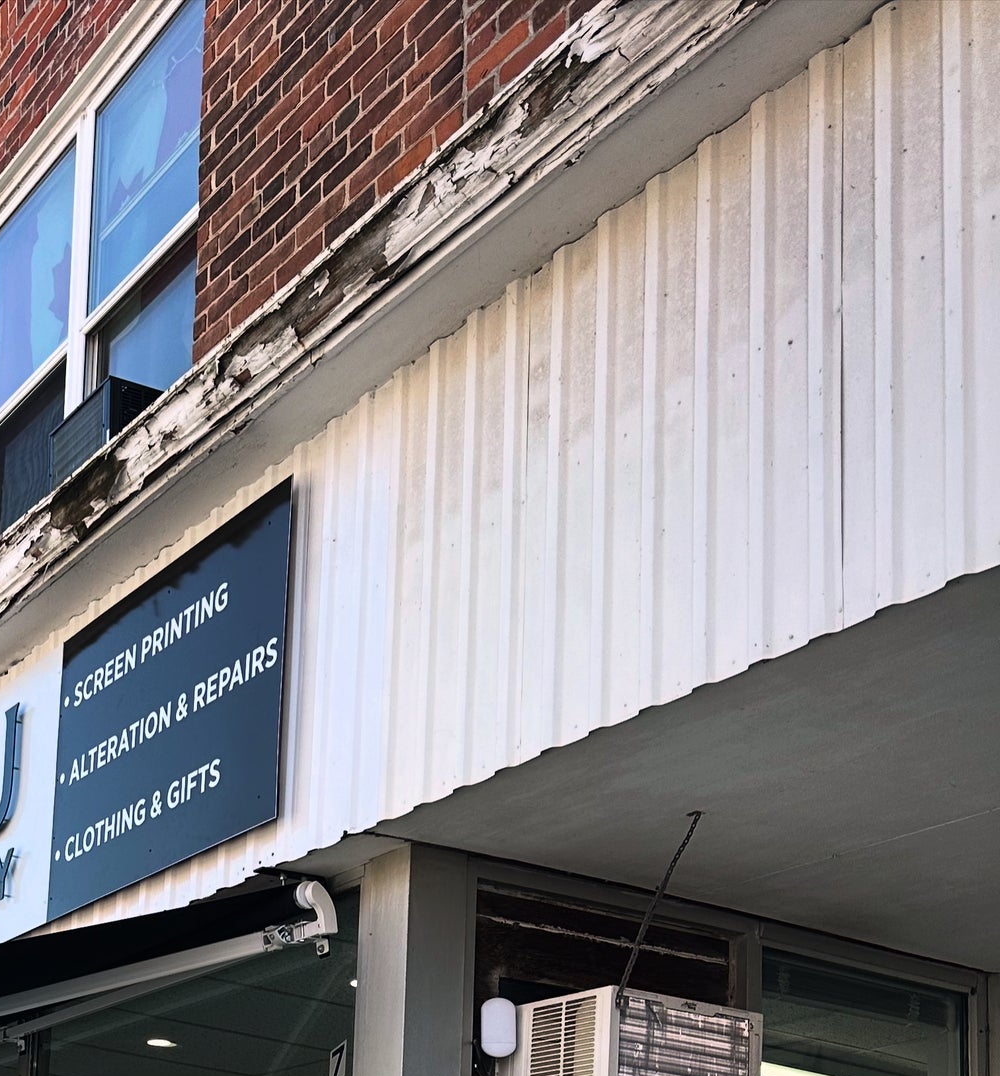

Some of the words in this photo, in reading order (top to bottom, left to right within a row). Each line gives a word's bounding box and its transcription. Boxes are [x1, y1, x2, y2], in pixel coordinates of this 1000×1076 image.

[73, 642, 137, 707] SCREEN
[140, 582, 230, 665] PRINTING
[68, 701, 172, 785] ALTERATION
[175, 692, 188, 719] &
[192, 637, 279, 706] REPAIRS
[64, 797, 147, 862] CLOTHING
[149, 790, 162, 816] &
[166, 758, 222, 810] GIFTS
